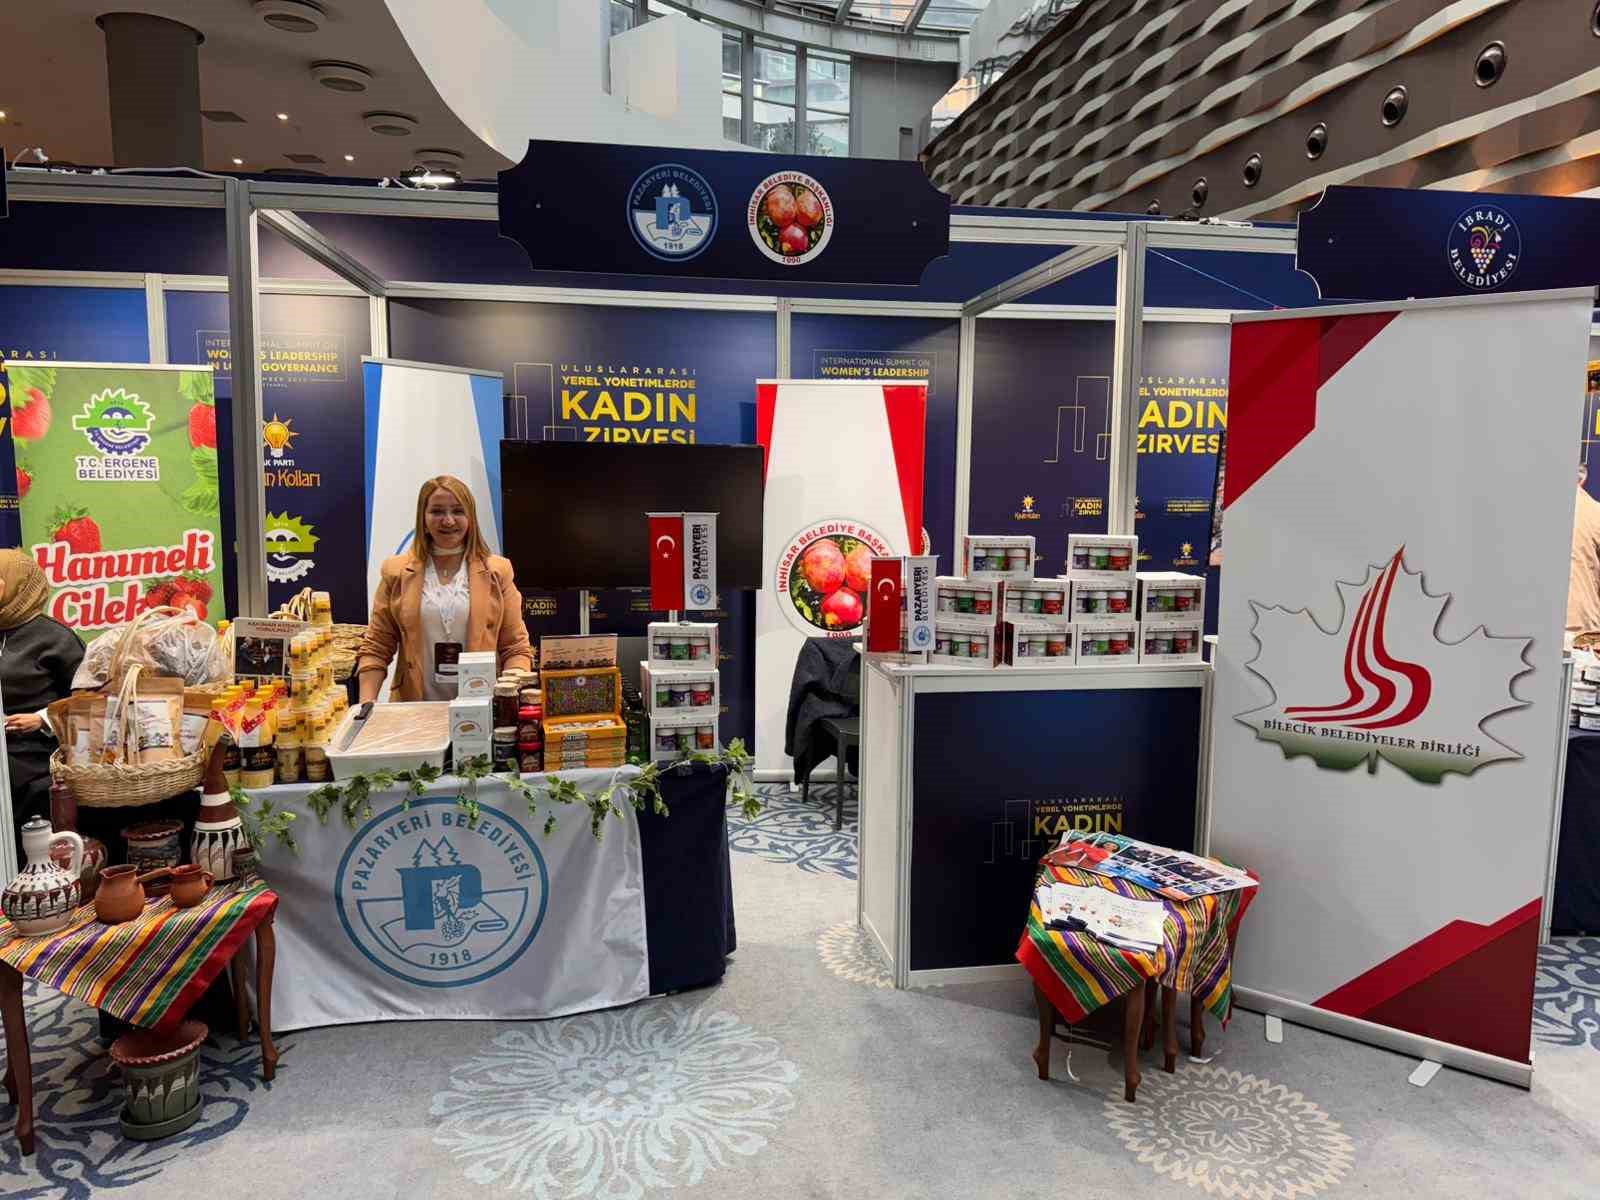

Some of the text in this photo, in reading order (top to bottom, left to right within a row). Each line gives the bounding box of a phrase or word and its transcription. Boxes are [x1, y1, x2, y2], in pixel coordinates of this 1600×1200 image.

[270, 351, 337, 361] LEADERSHIP
[822, 357, 883, 366] INTERNATIONAL
[261, 363, 338, 373] GOVERNANCE
[561, 364, 696, 376] ULUSLARARASI
[821, 367, 929, 377] WOMEN'S LEADERSHIP
[562, 375, 601, 386] YEREL
[561, 390, 696, 422] KADIN
[78, 458, 156, 468] T.C. ERGENE
[798, 522, 855, 545] BELEDİYE
[1263, 719, 1482, 758] BİLECİK BELEDİYELER BİRLİĞİ
[1035, 813, 1122, 834] KADIN
[352, 810, 432, 891] PAZARYERİ
[430, 949, 472, 965] 1918
